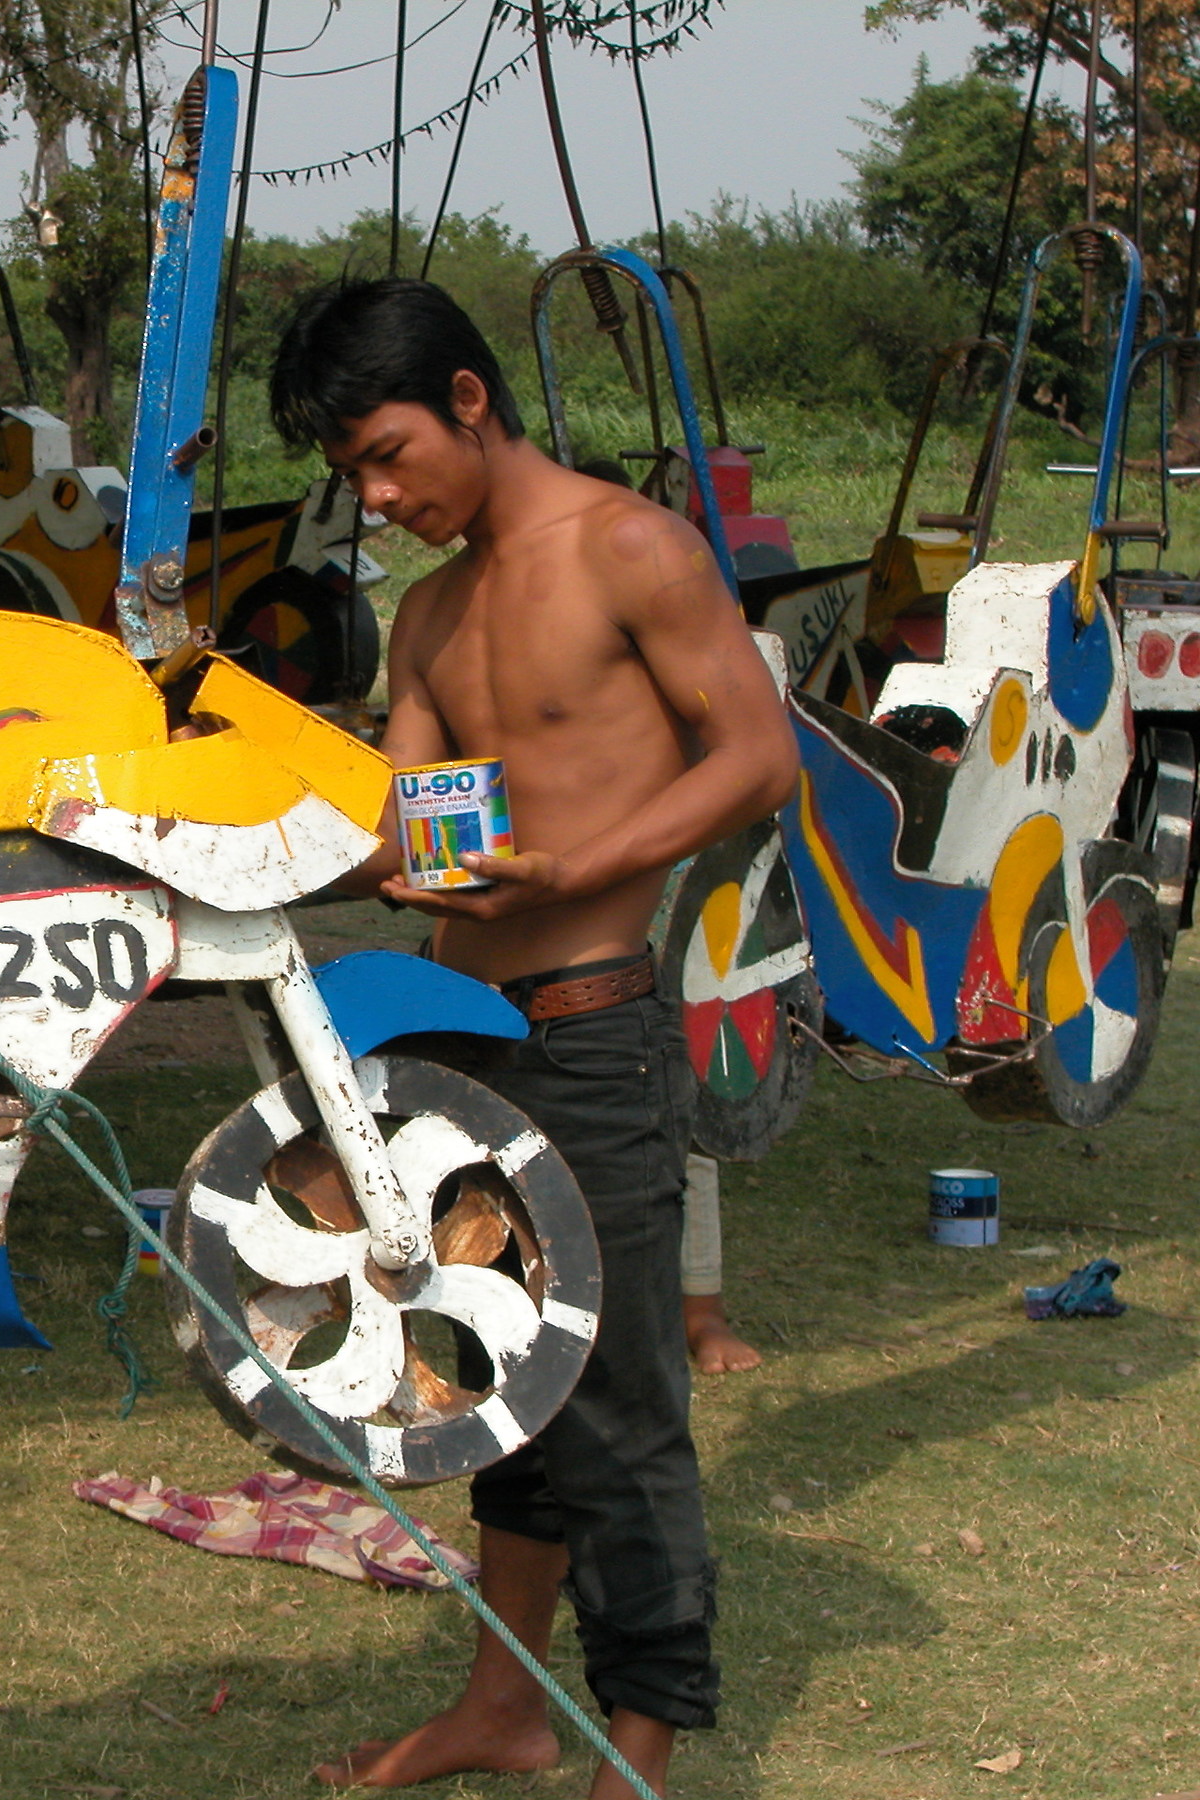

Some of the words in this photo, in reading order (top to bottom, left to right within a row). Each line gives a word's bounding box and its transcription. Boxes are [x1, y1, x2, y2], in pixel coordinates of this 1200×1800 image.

[401, 771, 476, 799] U-90
[407, 797, 445, 806] SYNTHETIC
[448, 794, 470, 802] RESIN
